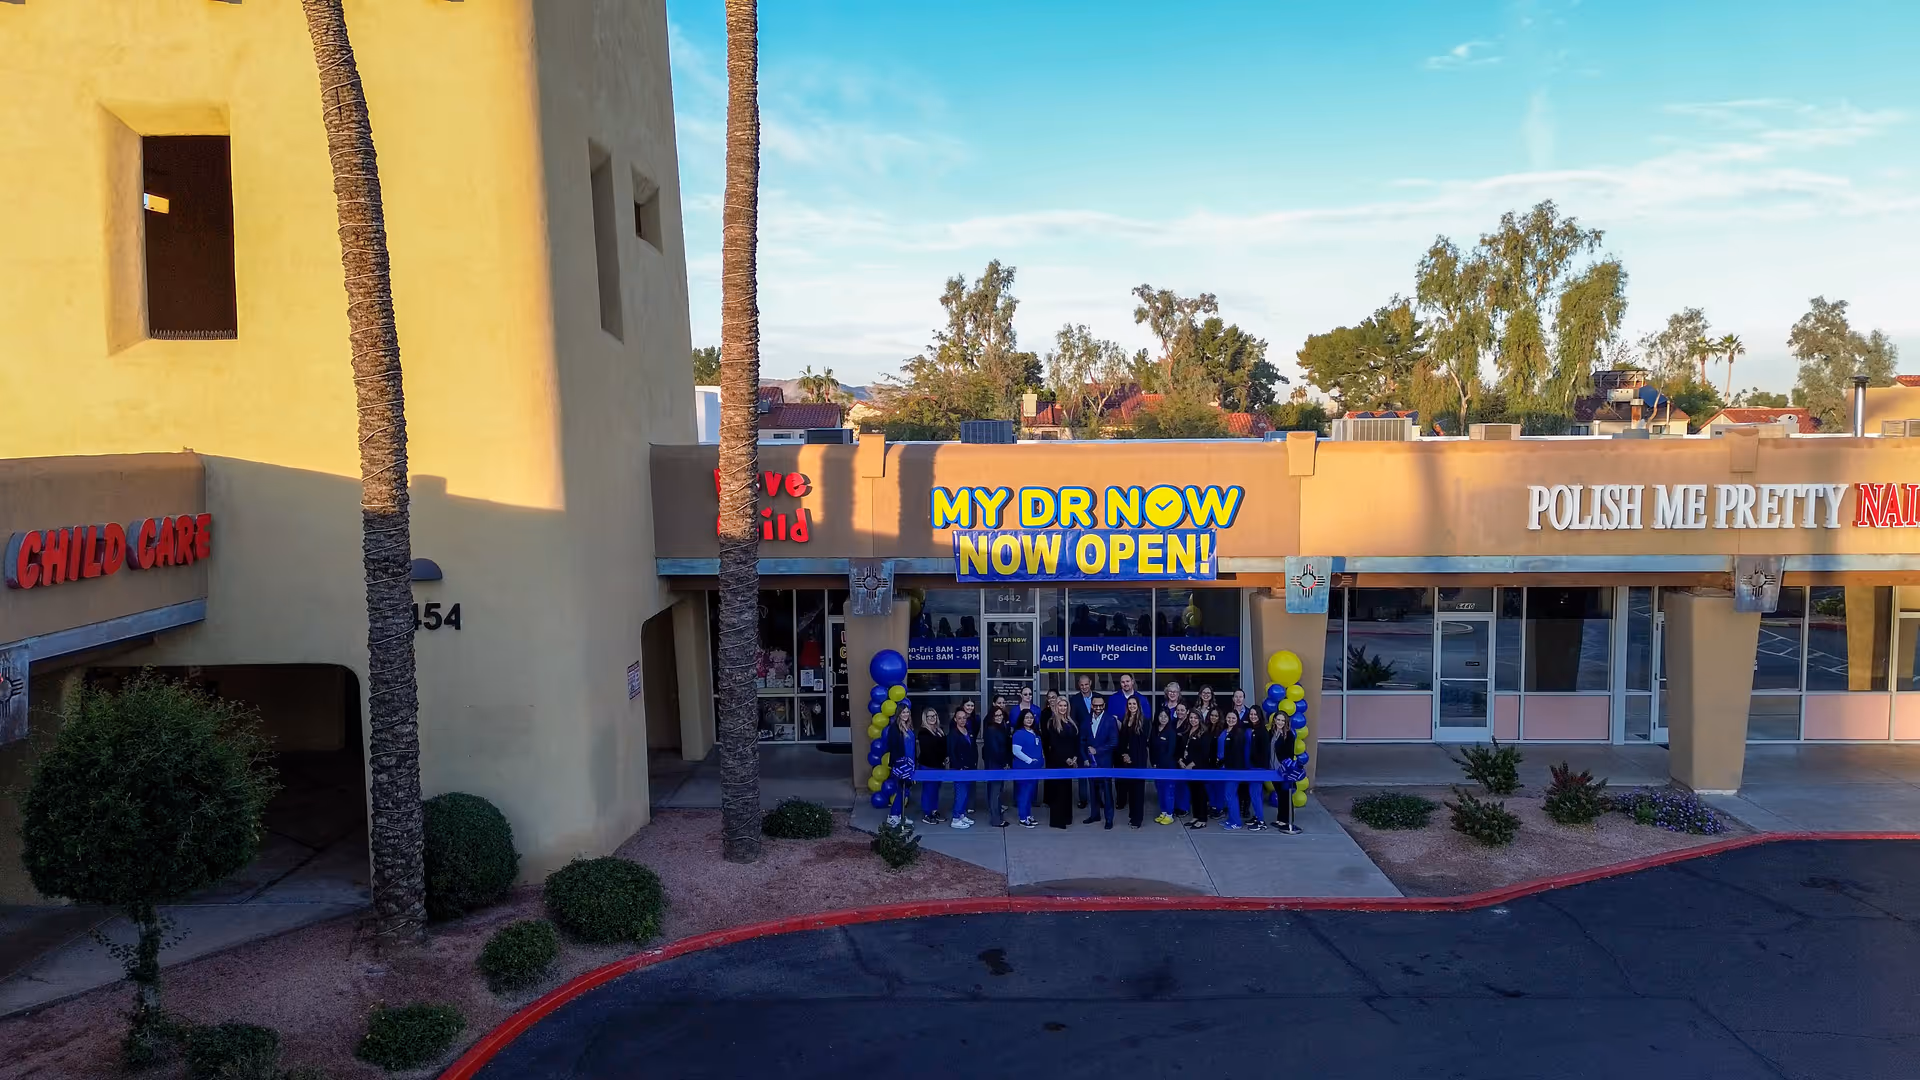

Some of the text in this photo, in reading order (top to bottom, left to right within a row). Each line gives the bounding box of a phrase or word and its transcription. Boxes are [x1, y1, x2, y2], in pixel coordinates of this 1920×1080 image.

[931, 484, 1244, 530] MY DR NOW
[1526, 483, 1920, 531] POLISH ME PRETTY NAI
[5, 512, 212, 589] CHILD CARE
[959, 533, 1211, 575] NOW OPEN!
[998, 594, 1021, 602] 6442
[1046, 644, 1059, 652] All
[1072, 644, 1148, 653] Family Medicine
[1169, 644, 1212, 652] Schedule
[936, 653, 954, 661] 8AM
[962, 653, 980, 661] 4PM
[1041, 654, 1064, 662] Ages
